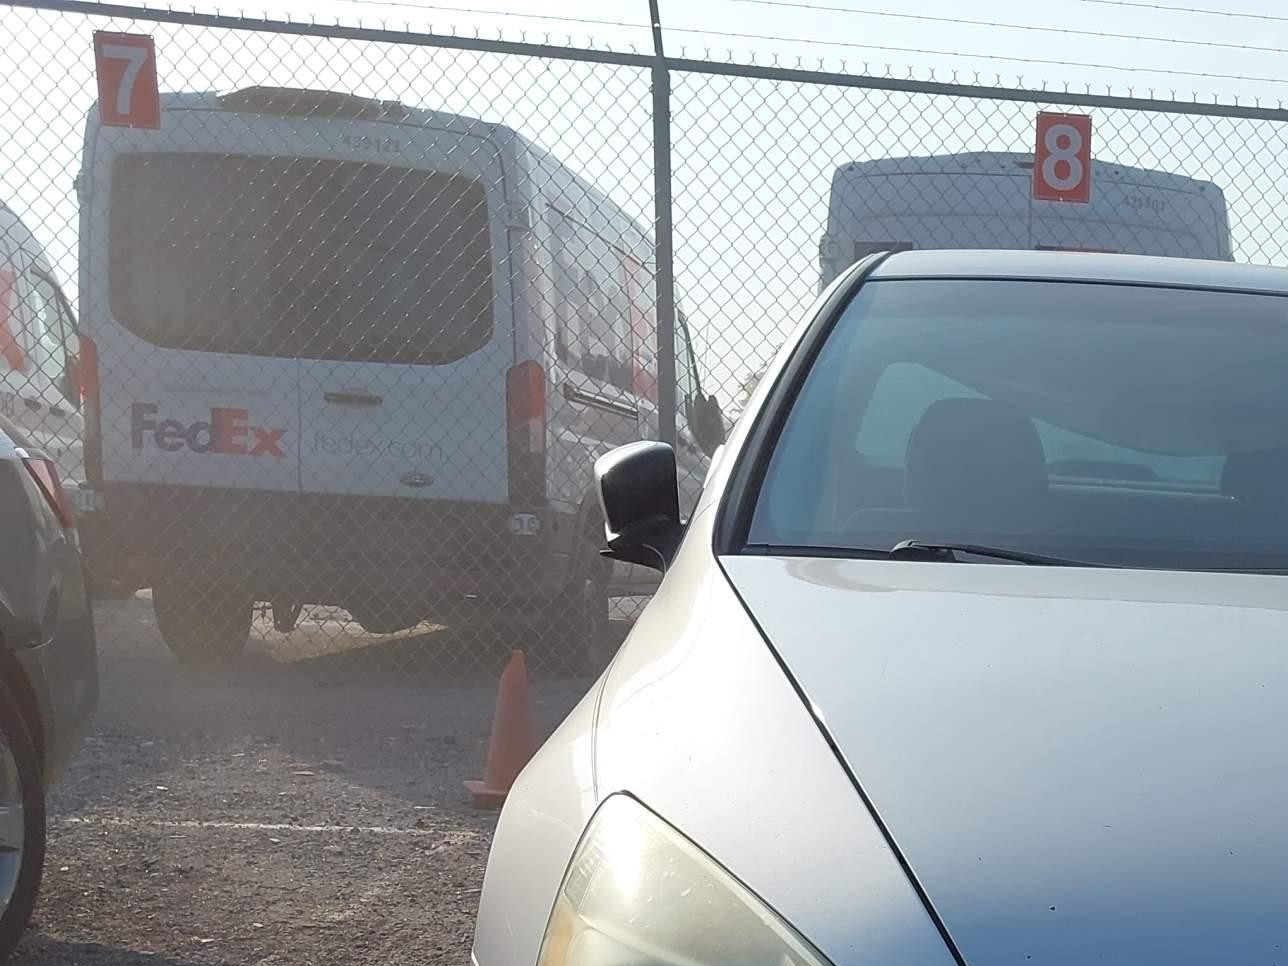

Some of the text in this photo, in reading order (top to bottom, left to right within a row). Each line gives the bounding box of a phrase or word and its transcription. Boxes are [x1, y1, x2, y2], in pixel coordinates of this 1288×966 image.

[101, 44, 148, 114] 7
[1042, 123, 1083, 191] 8
[131, 402, 288, 459] FedEx
[313, 430, 443, 460] fedex.com
